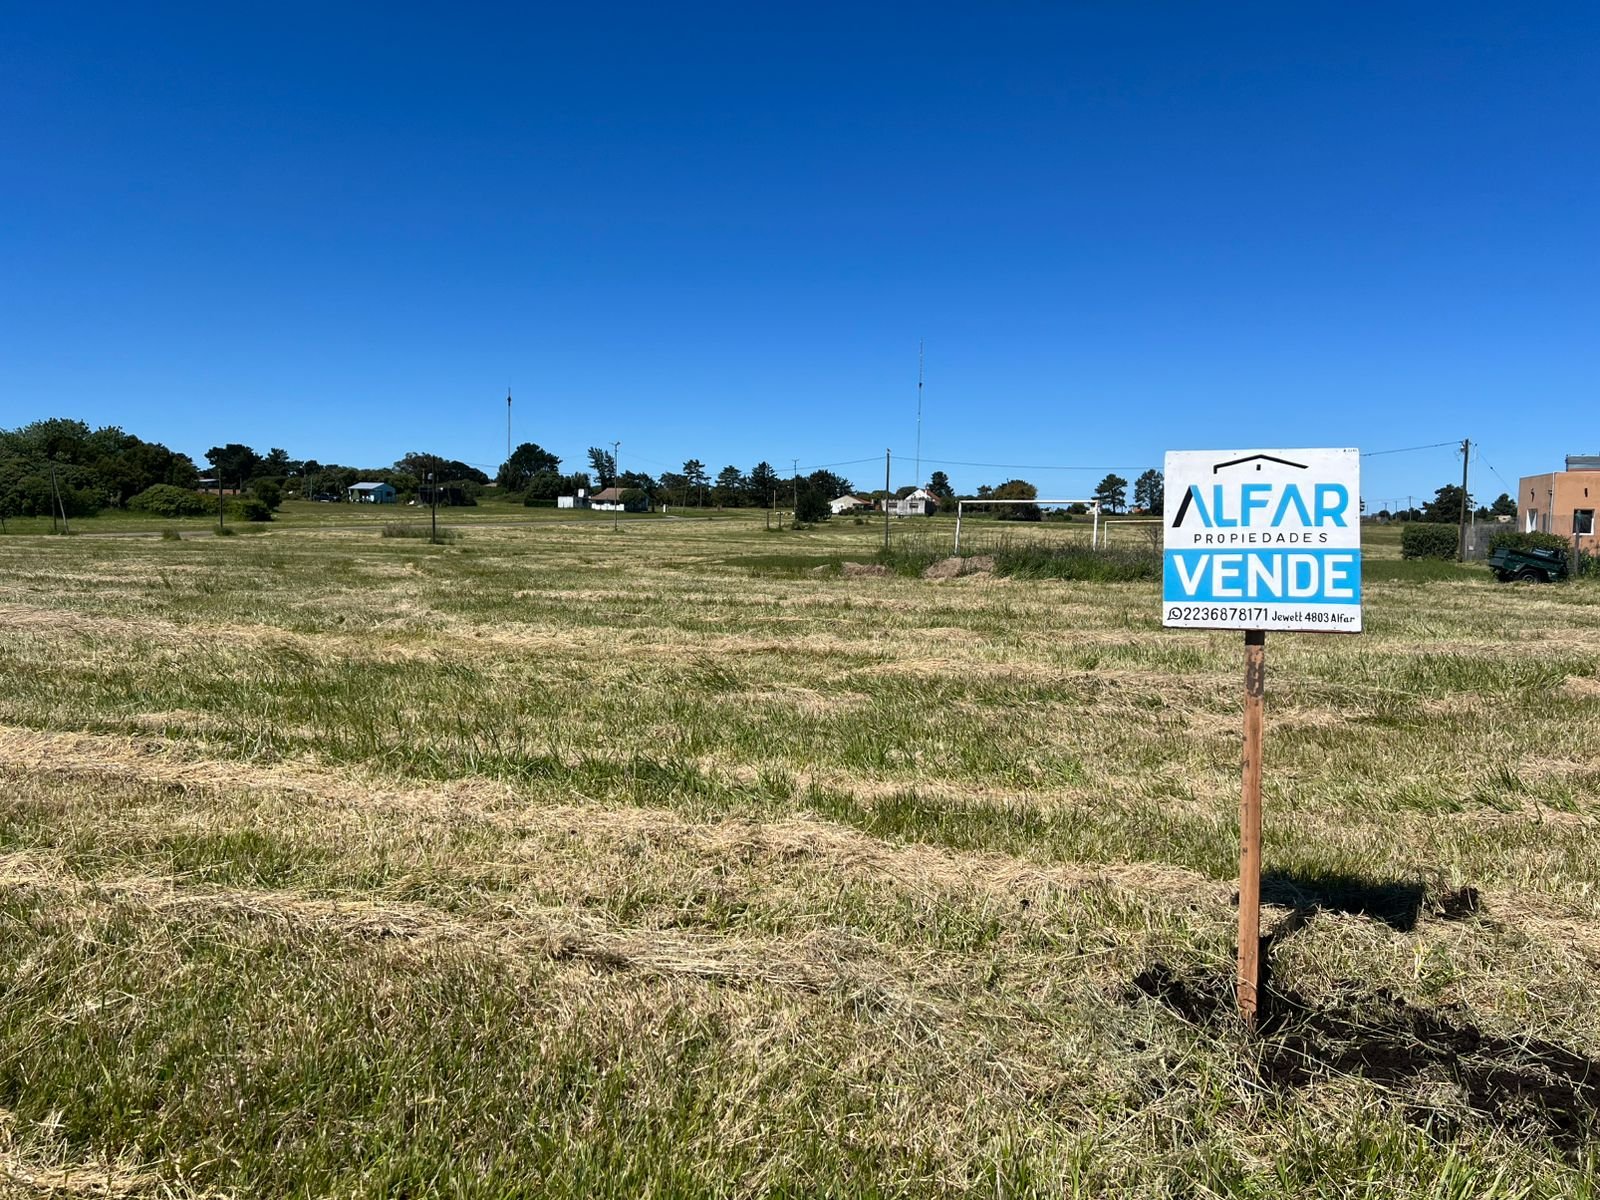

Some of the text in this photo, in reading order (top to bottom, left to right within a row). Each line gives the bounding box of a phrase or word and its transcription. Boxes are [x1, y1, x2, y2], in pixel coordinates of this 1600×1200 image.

[1172, 483, 1349, 528] ALFAR
[1193, 532, 1329, 544] PROPIEDADES
[1172, 553, 1353, 598] VENDE
[1183, 608, 1268, 621] 2236878171
[1271, 611, 1303, 623] Jewett
[1304, 612, 1330, 623] 4803
